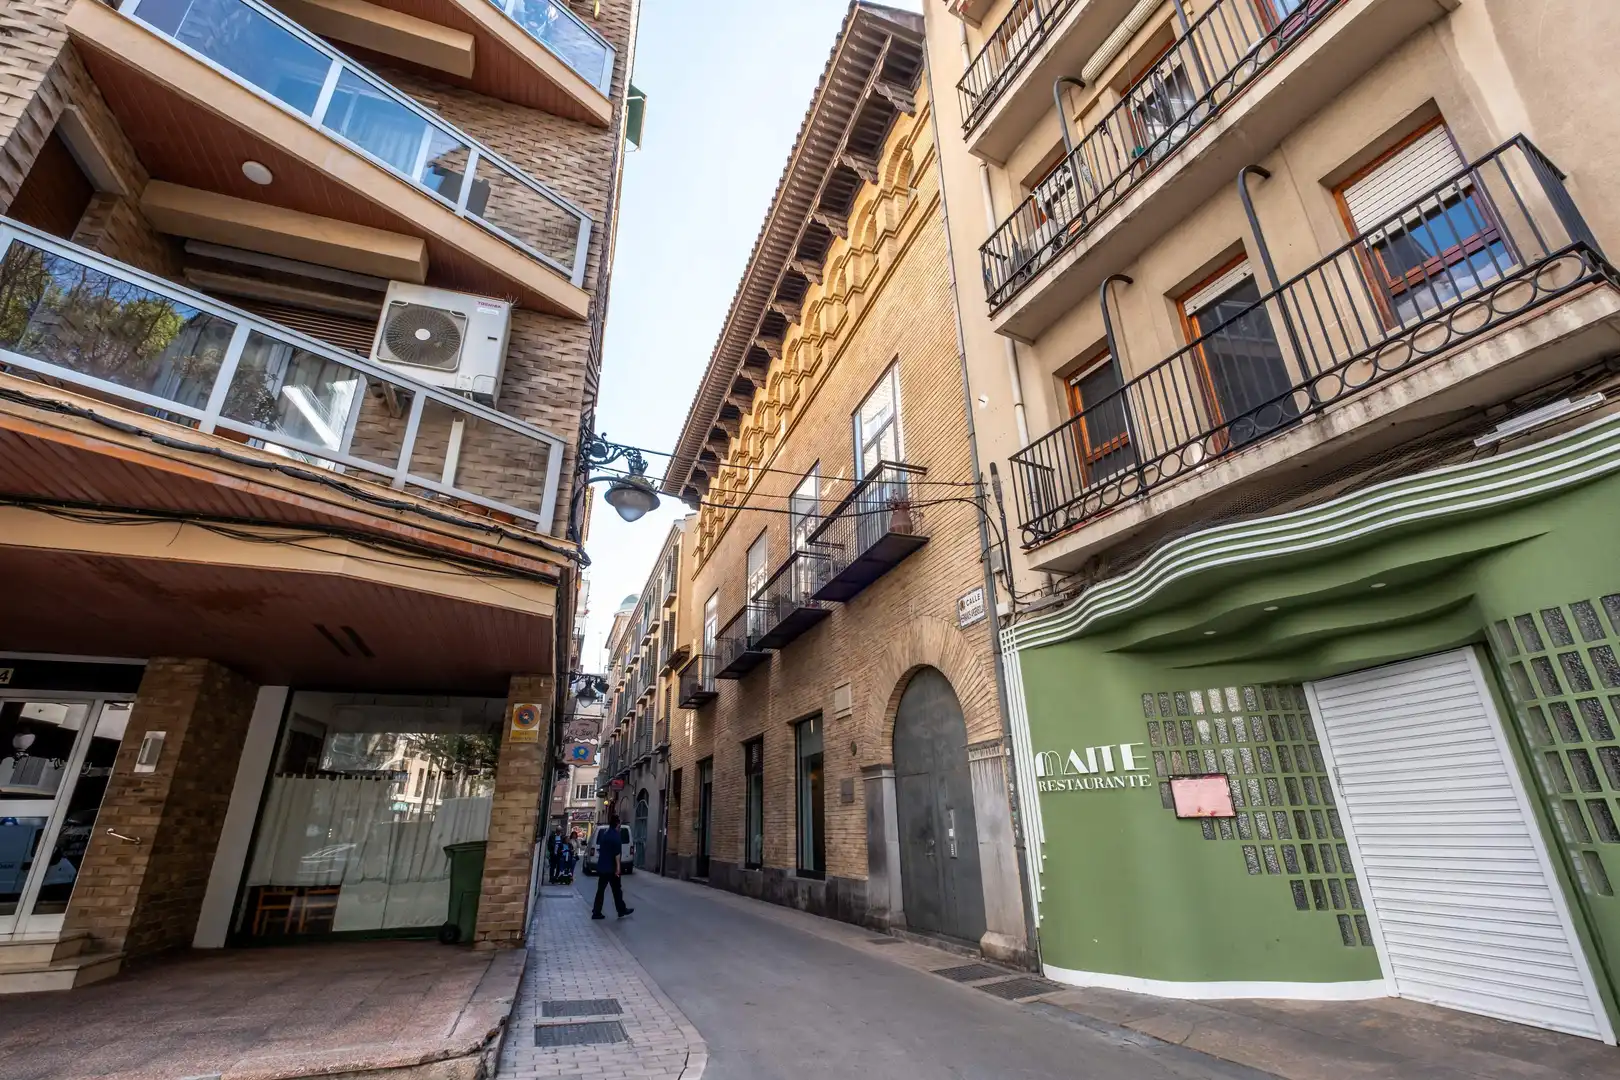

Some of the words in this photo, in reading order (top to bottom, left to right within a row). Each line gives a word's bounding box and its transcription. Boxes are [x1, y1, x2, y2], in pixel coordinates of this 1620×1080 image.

[966, 593, 980, 606] CALLE
[0, 669, 9, 682] 4
[1035, 742, 1150, 777] MAITE
[1039, 774, 1152, 792] RESTAURANTE
